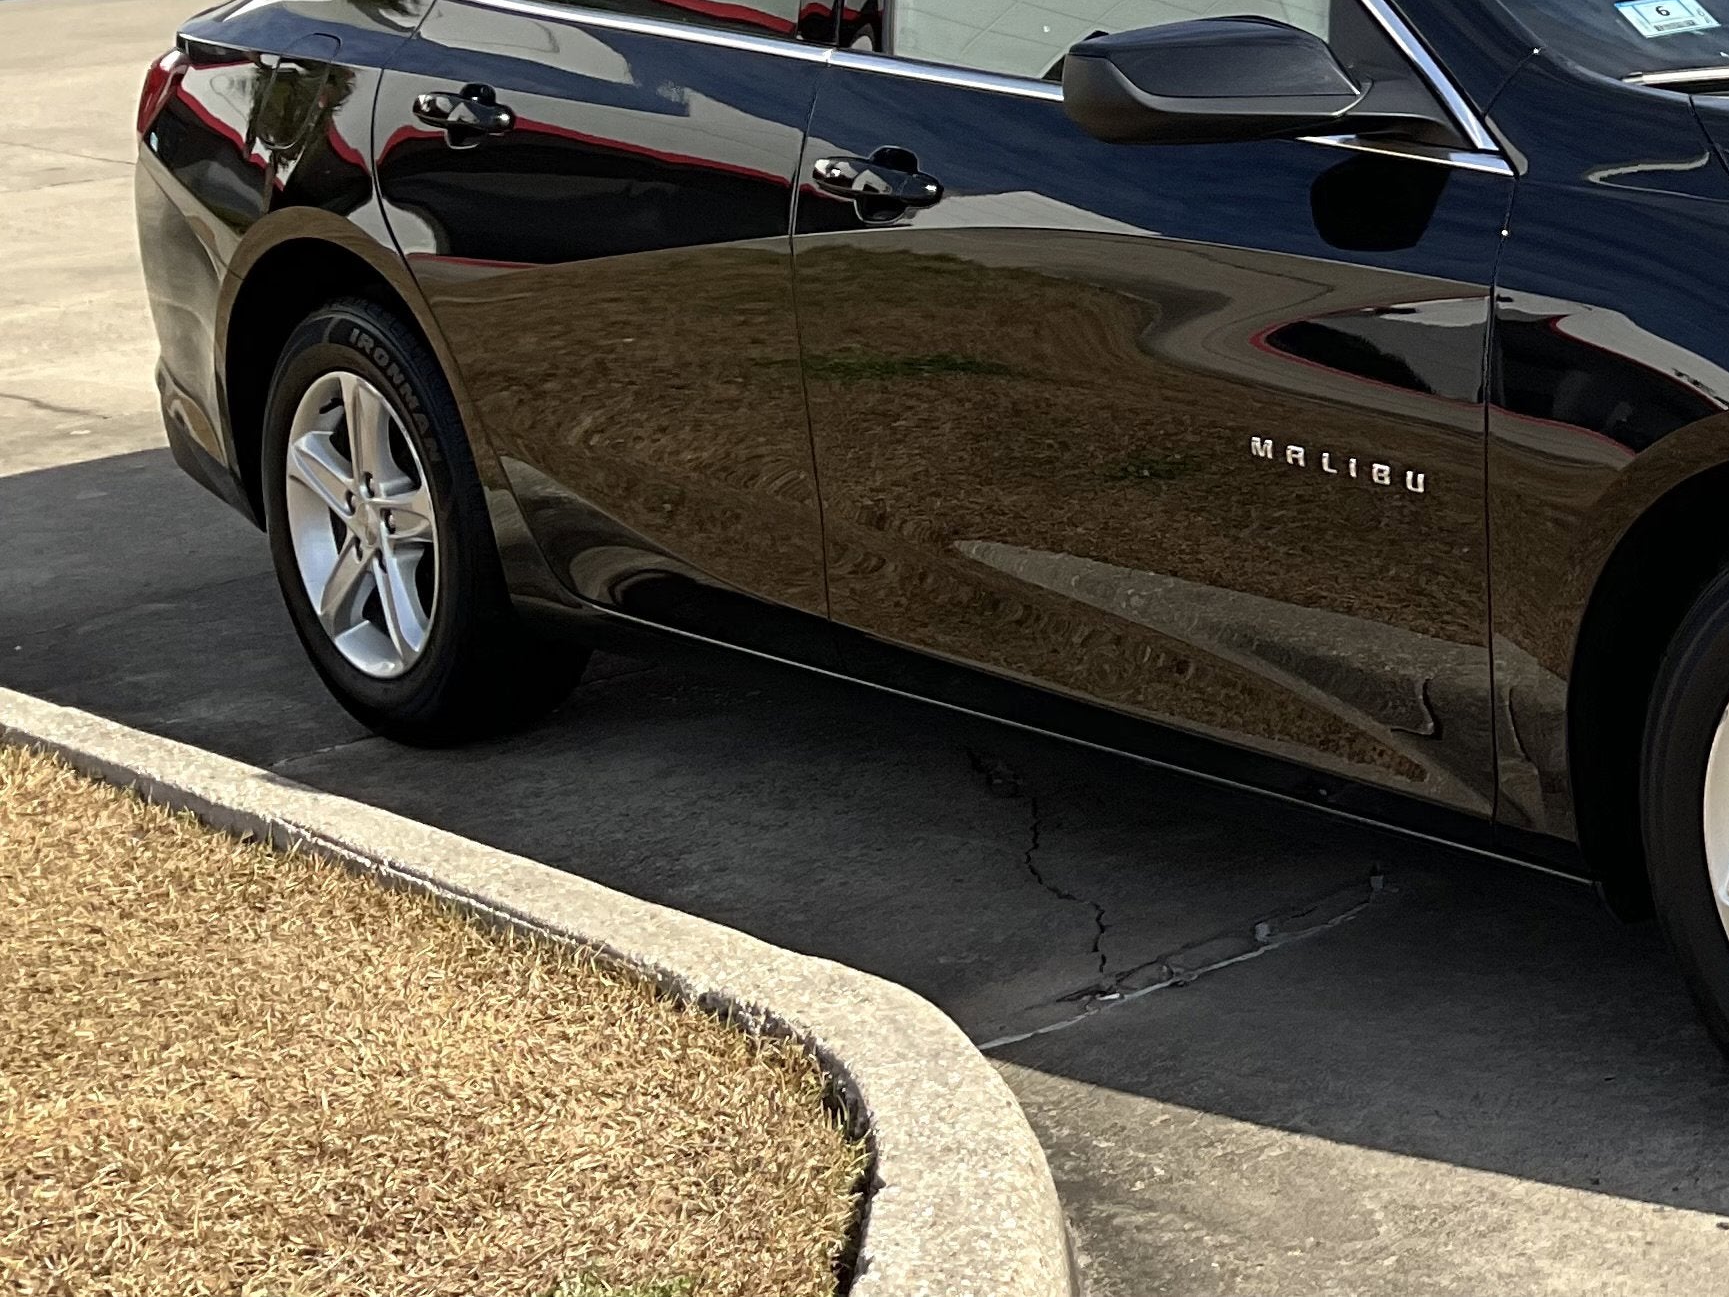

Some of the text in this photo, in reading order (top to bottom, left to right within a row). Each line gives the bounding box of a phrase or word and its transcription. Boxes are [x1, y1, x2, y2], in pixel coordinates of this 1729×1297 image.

[1655, 6, 1671, 17] 6
[350, 327, 441, 461] IRONMAN
[1251, 436, 1425, 493] MALIBU
